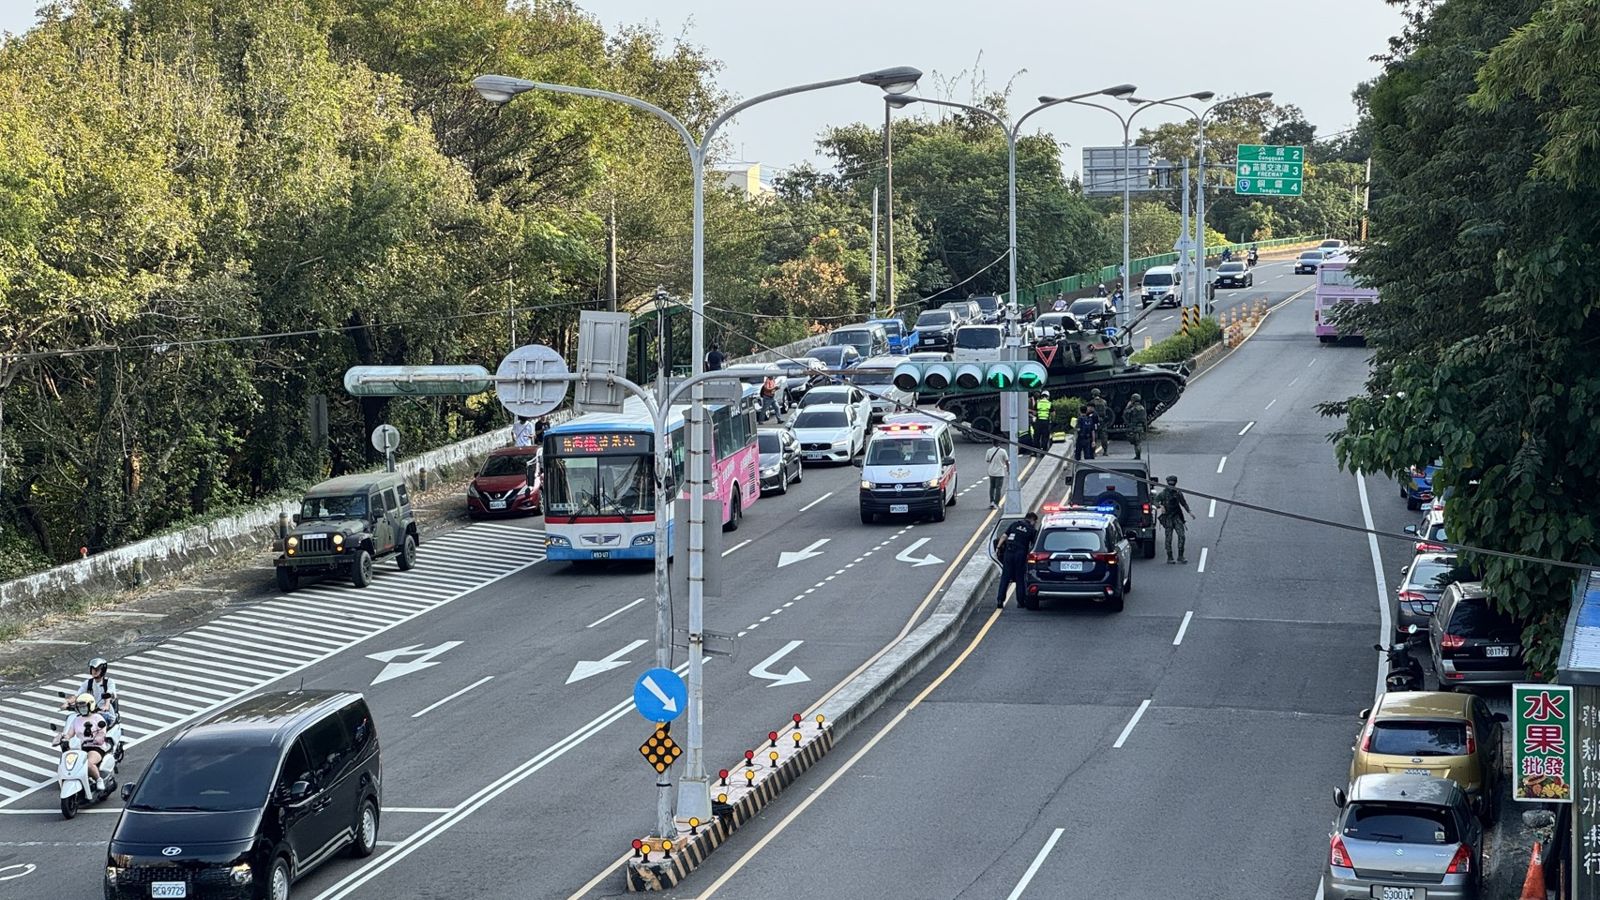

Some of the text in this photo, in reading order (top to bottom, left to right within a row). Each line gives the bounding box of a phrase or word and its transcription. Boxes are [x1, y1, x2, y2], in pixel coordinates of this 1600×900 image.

[1292, 150, 1300, 160] 2
[1292, 166, 1299, 176] 3
[1290, 183, 1298, 192] 4
[1523, 691, 1565, 754] 水果
[1522, 756, 1565, 776] 批發
